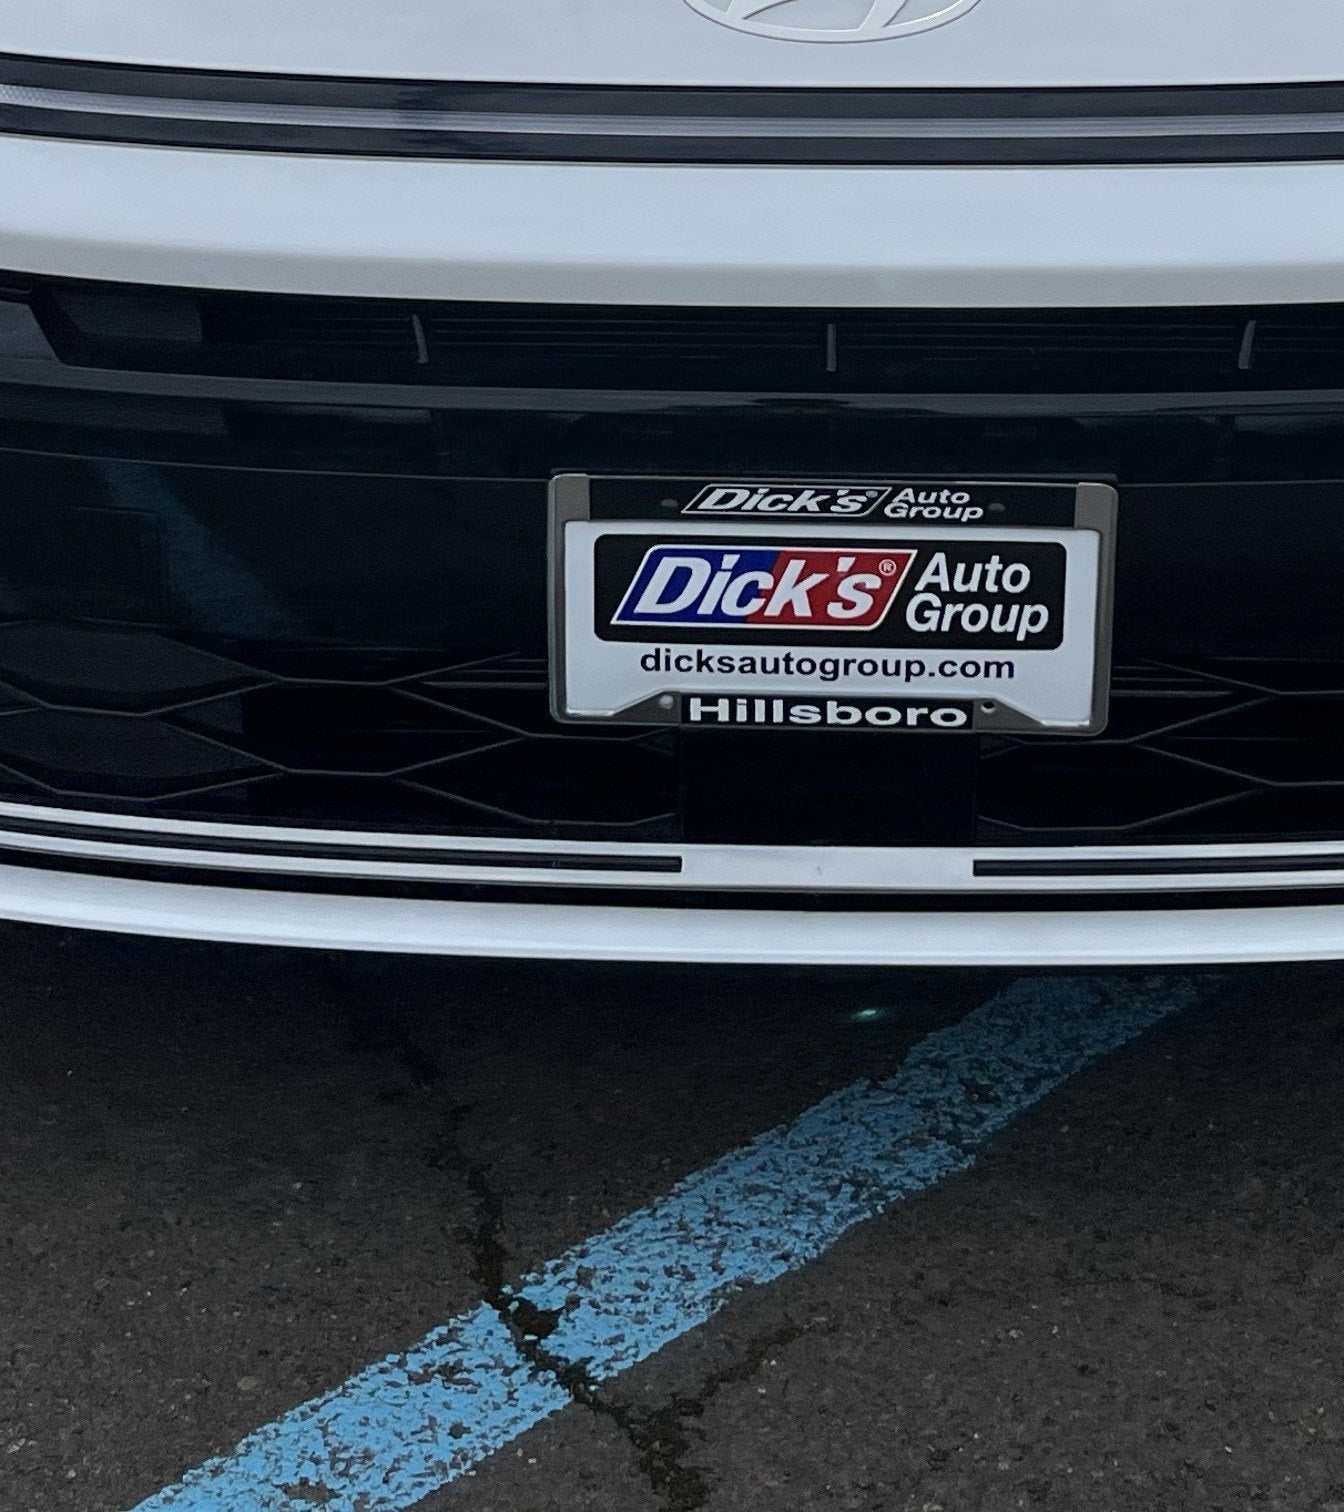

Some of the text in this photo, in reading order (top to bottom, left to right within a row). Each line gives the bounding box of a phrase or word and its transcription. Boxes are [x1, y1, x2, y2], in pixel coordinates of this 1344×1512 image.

[892, 488, 970, 504] Auto
[884, 503, 984, 522] Group
[915, 552, 1031, 593] Auto
[905, 593, 1050, 641] Group
[640, 647, 1016, 682] dicksautogroup.com
[688, 698, 968, 728] Hillsboro
